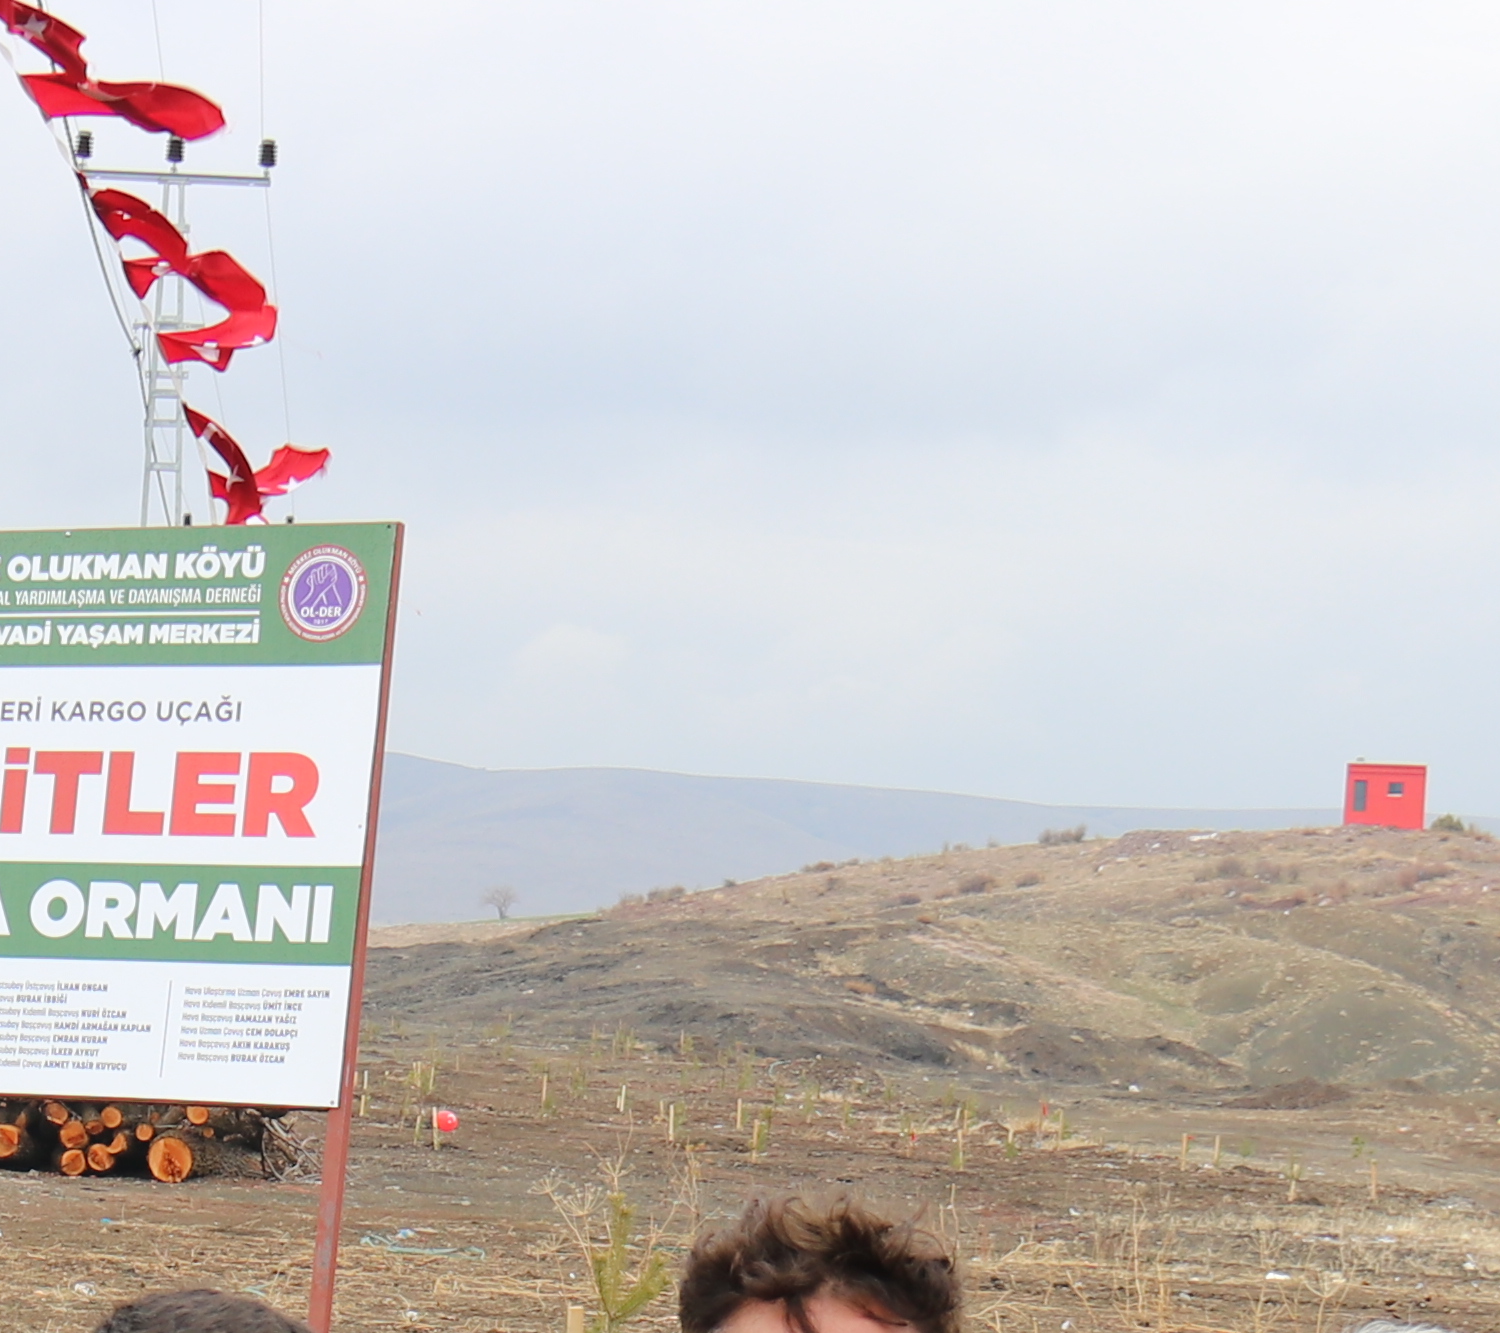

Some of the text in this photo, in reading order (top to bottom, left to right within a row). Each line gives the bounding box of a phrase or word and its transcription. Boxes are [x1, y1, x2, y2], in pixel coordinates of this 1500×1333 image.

[7, 553, 173, 581] OLUKMAN
[175, 546, 266, 579] KÖYÜ
[14, 589, 105, 609] YARDIMLAŞMA
[109, 588, 126, 605] VE
[128, 587, 201, 608] DAYANIŞMA
[205, 583, 261, 604] DERNEĞİ
[300, 606, 342, 618] OL-DER
[57, 624, 144, 649] YAŞAM
[148, 619, 260, 645] MERKEZİ
[51, 701, 147, 724] KARGO
[156, 695, 242, 727] UÇAĞI
[29, 879, 334, 944] ORMANI
